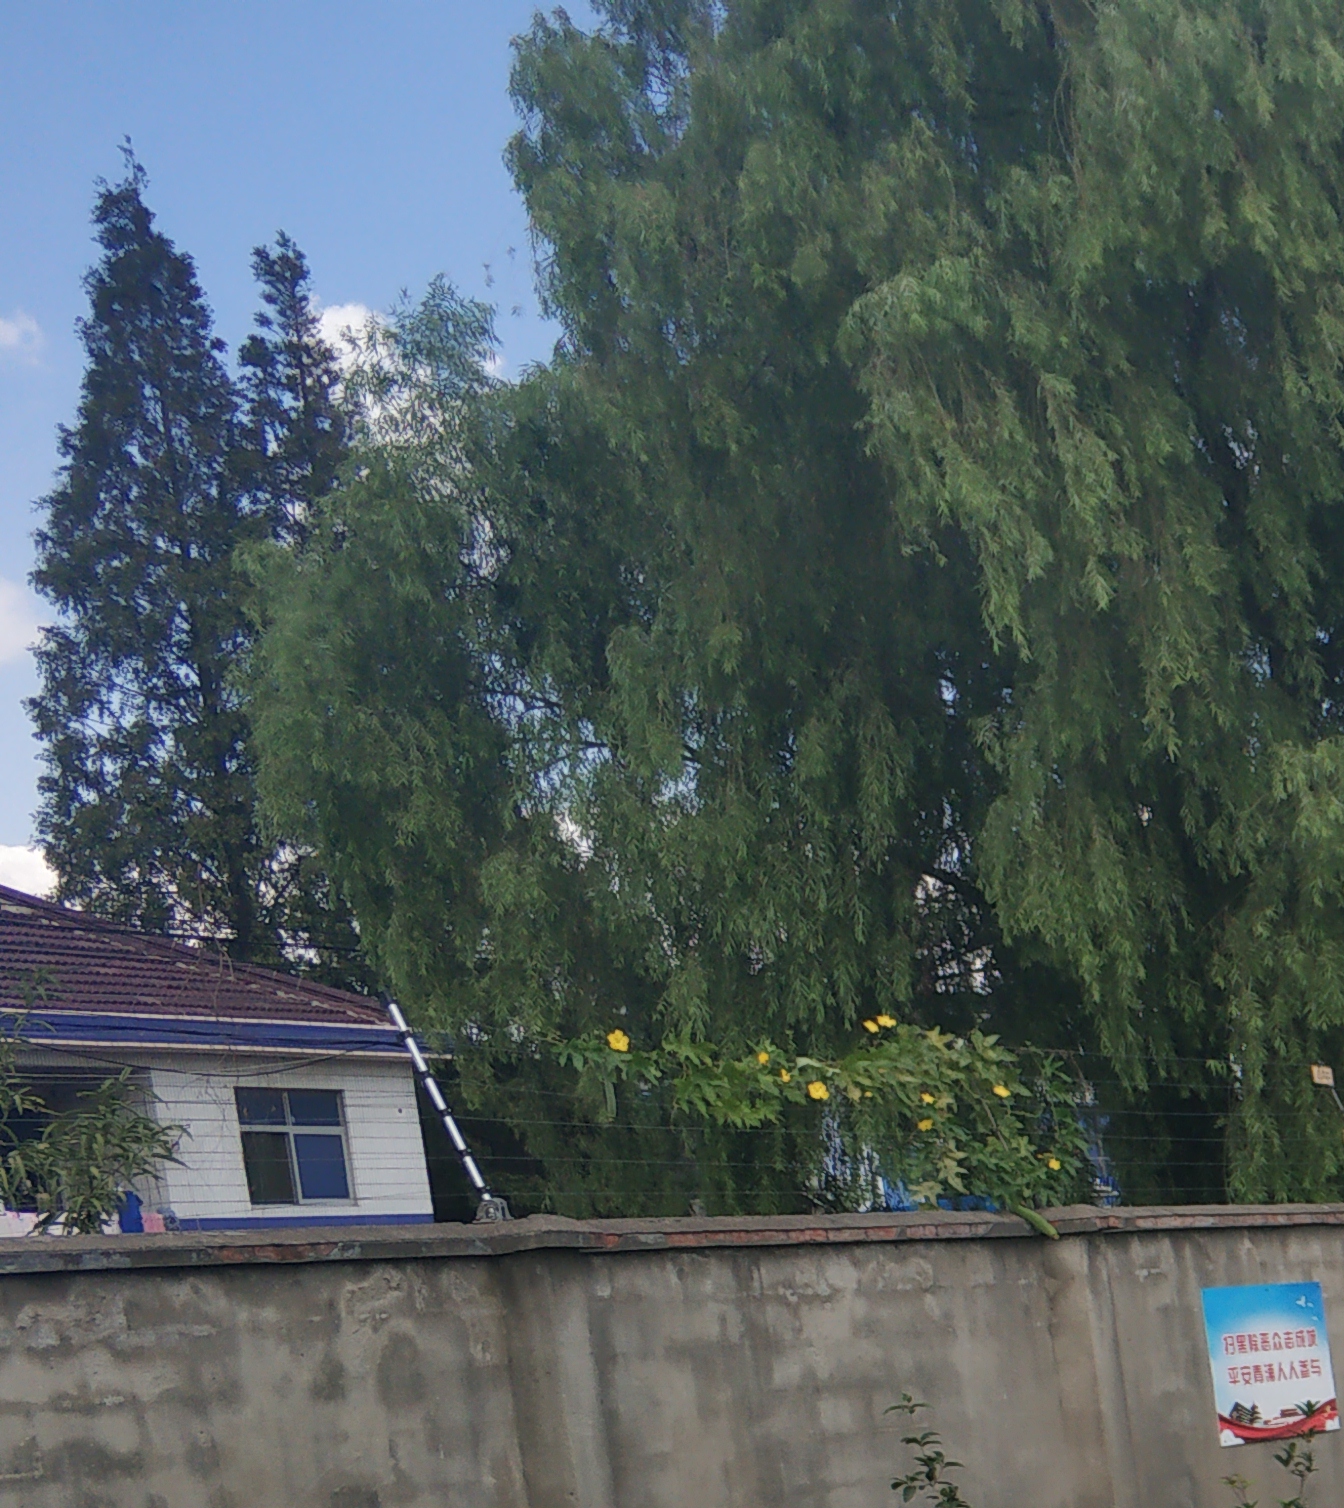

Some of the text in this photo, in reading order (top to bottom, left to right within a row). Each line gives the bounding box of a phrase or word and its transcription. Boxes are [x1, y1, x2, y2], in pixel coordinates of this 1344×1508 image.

[1227, 1358, 1322, 1385] 平安青浦人人参与
